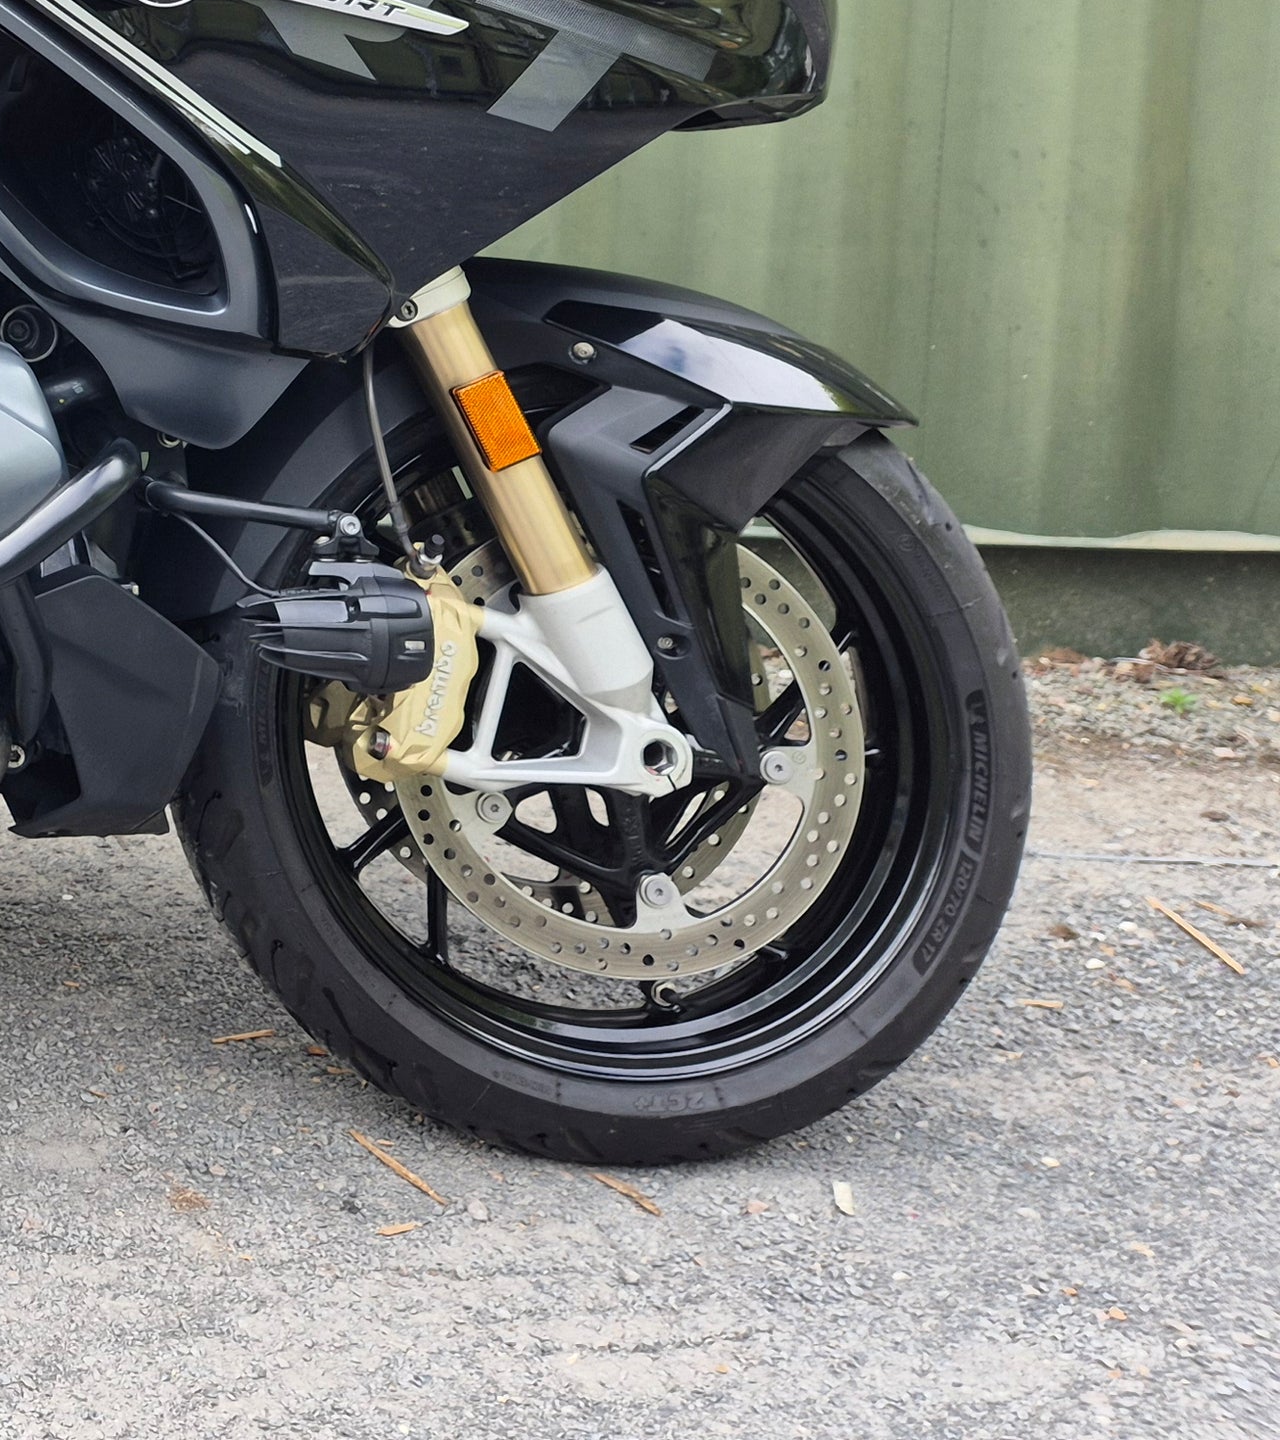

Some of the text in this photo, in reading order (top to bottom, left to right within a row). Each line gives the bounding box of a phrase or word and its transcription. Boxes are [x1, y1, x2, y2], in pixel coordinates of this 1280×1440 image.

[414, 640, 458, 738] brembo
[966, 729, 990, 844] MICHELIN
[944, 860, 974, 920] 120/70
